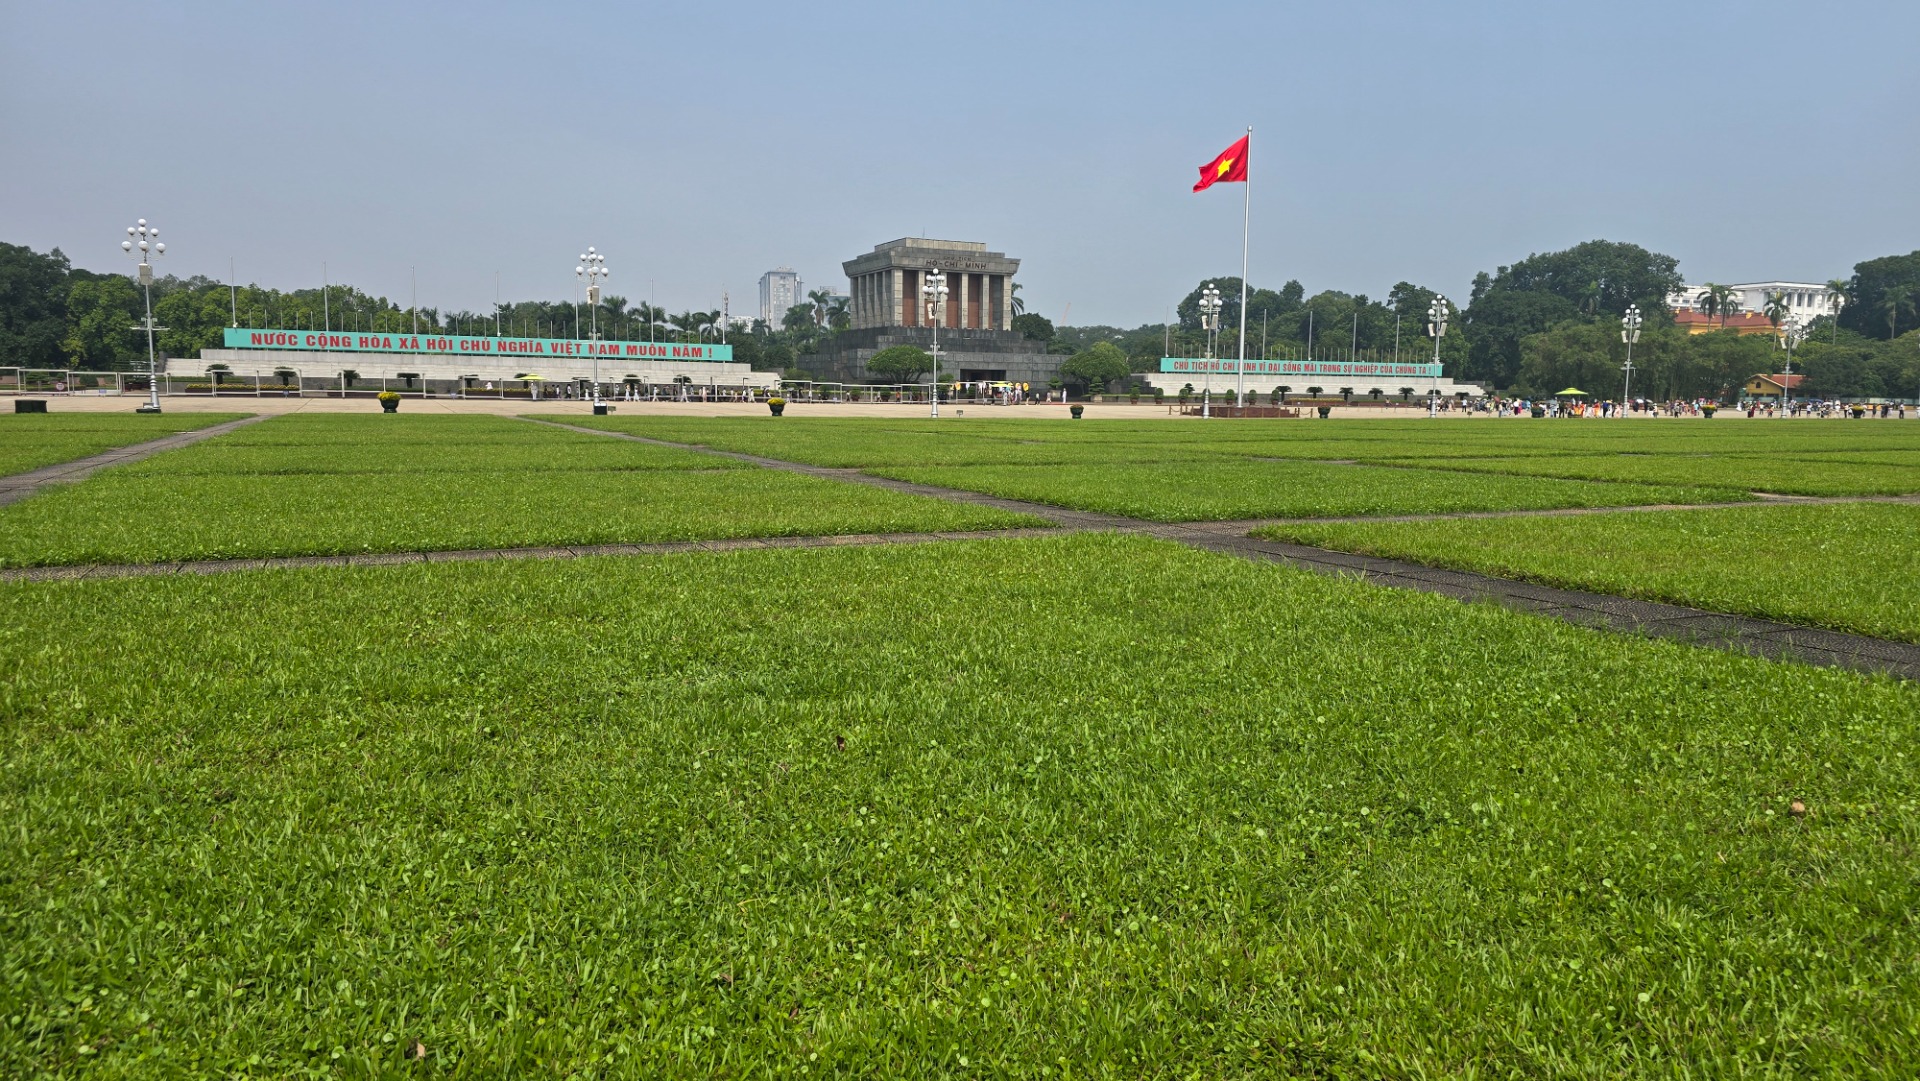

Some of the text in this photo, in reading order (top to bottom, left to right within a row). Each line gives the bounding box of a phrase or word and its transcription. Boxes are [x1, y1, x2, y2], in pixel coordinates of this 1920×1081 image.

[251, 333, 299, 346] NƯỚC
[306, 332, 352, 349] CỘNG
[359, 335, 392, 349] HÒA
[399, 335, 421, 350] XÃ
[427, 337, 453, 352] HỘI
[460, 337, 491, 352] CHỦ
[497, 339, 544, 353] NGHĨA
[551, 342, 582, 356] VIỆT
[588, 343, 620, 355] NAM
[626, 343, 667, 357] MUÔN
[673, 344, 703, 358] NĂM
[1319, 364, 1341, 373] TRONG
[1419, 366, 1427, 374] TA
